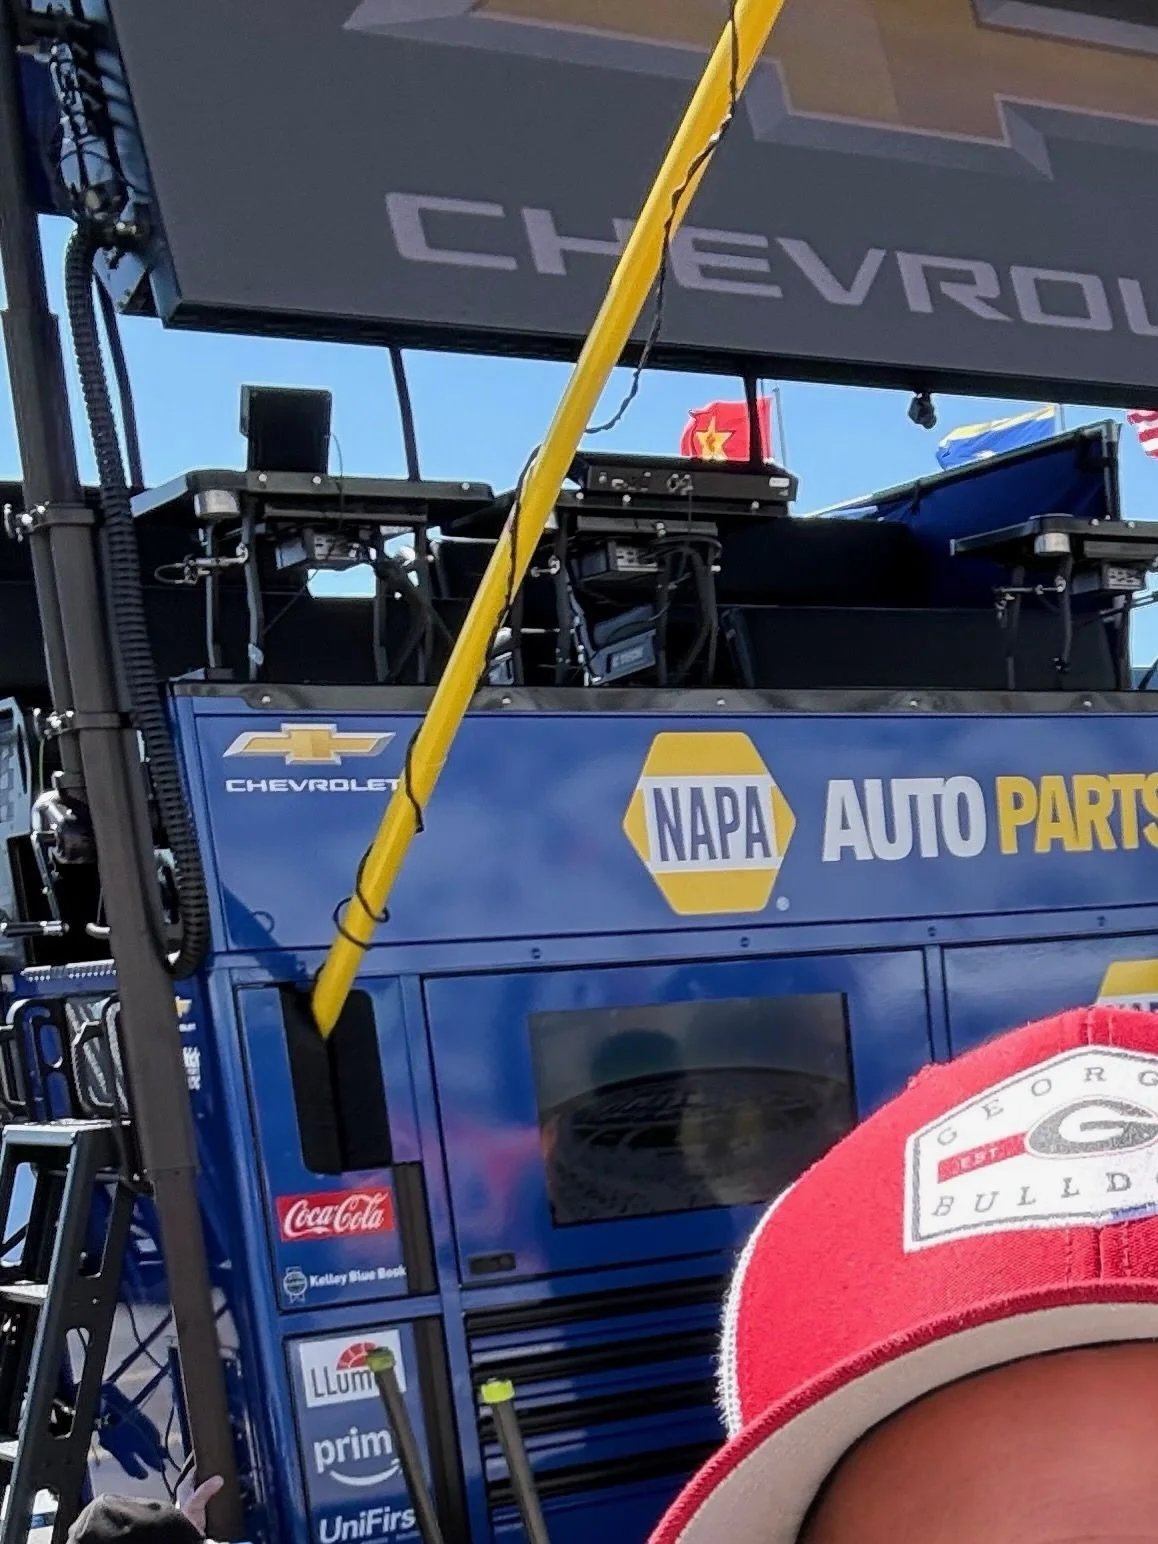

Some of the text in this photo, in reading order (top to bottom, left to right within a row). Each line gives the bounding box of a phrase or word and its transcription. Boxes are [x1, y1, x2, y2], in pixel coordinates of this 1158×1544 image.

[652, 785, 772, 862] NAPA
[822, 775, 987, 862] AUTO
[310, 1274, 347, 1287] Kelley
[349, 1269, 376, 1281] Blue
[311, 1366, 373, 1398] LLum
[313, 1426, 393, 1474] prim
[319, 1505, 416, 1544] UniFirs
